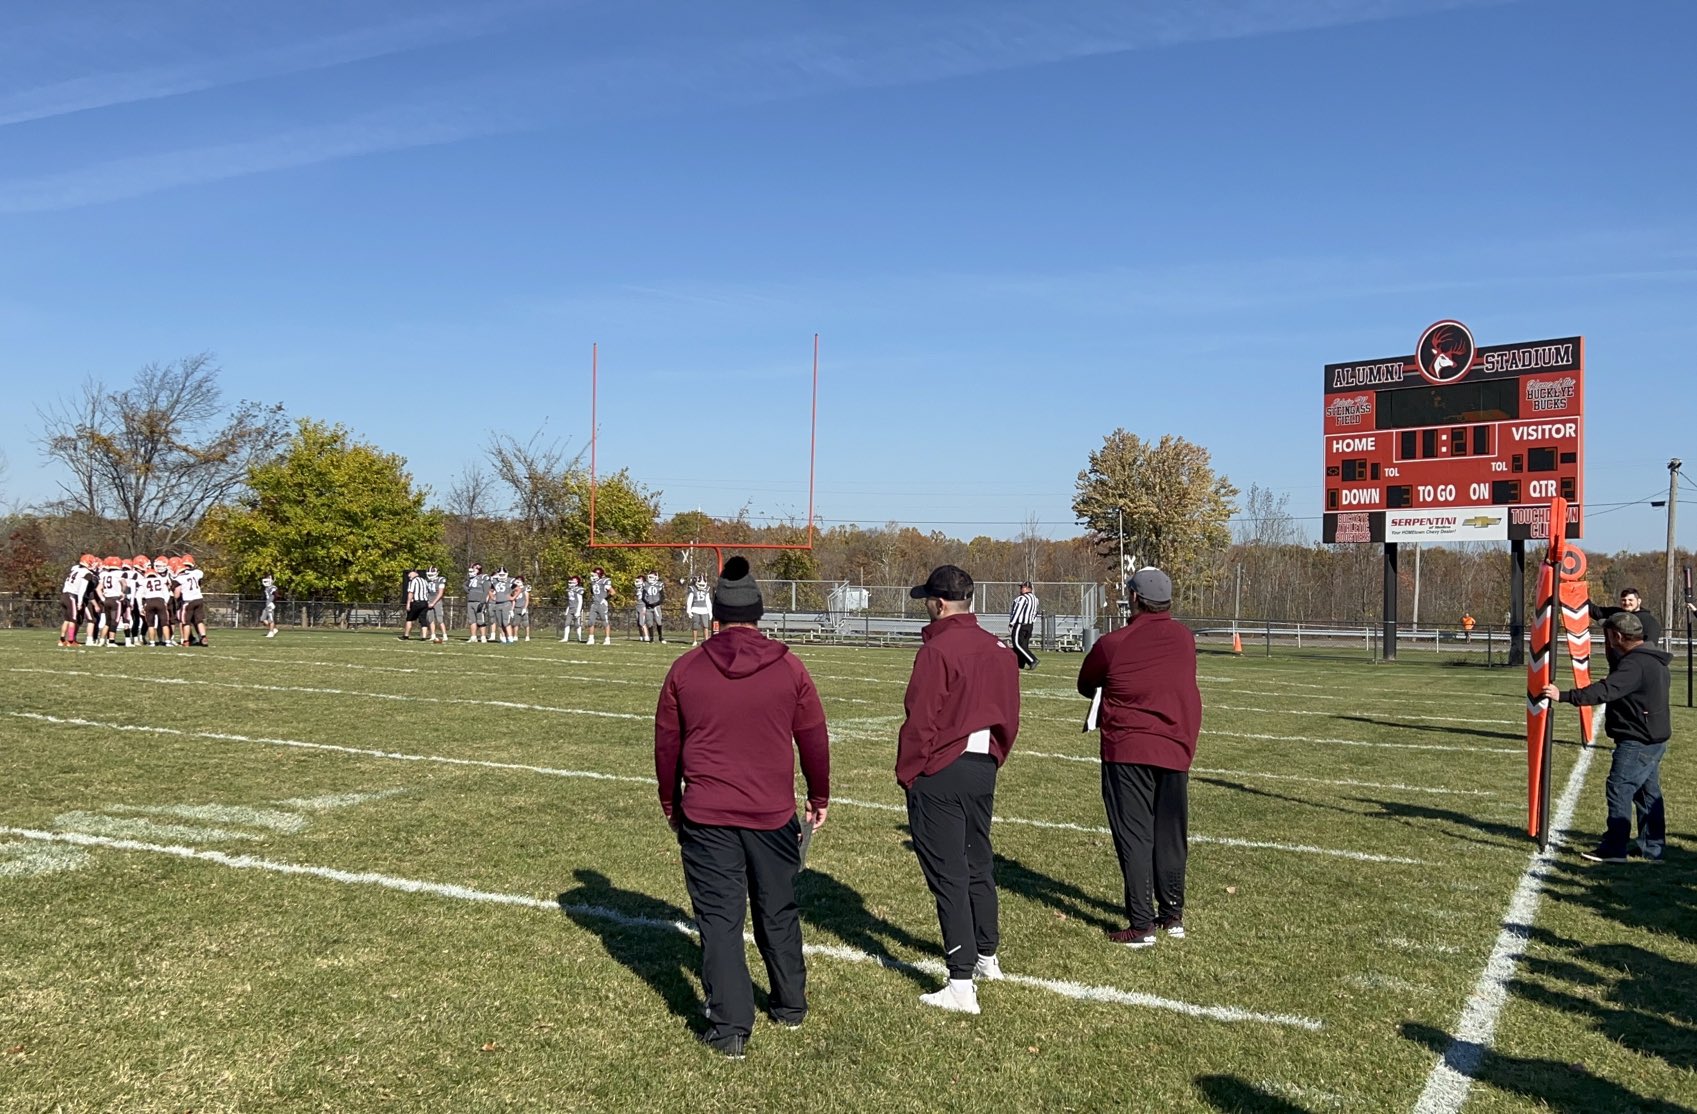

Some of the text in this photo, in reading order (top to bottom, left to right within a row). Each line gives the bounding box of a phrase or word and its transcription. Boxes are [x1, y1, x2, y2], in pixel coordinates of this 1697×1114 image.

[1483, 343, 1572, 373] STADIUM
[1333, 362, 1403, 388] ALUMNI
[1526, 386, 1574, 400] BUCKEYE
[1326, 402, 1371, 417] STEINGASS
[1532, 398, 1567, 411] BUCKS
[1335, 414, 1361, 426] FIELD
[1512, 423, 1577, 441] VISITOR
[1332, 437, 1376, 453] HOME
[1384, 467, 1400, 477] TOL
[1491, 461, 1508, 472] TOL
[1342, 488, 1380, 505] DOWN
[1418, 484, 1456, 502] TO GO
[1469, 483, 1489, 500] ON
[1529, 480, 1557, 498] QTR
[1391, 517, 1457, 527] SERPENTINI
[1511, 507, 1579, 524] TOUCHDN
[146, 579, 161, 592] 42
[187, 576, 199, 591] 71
[495, 581, 506, 593] 65
